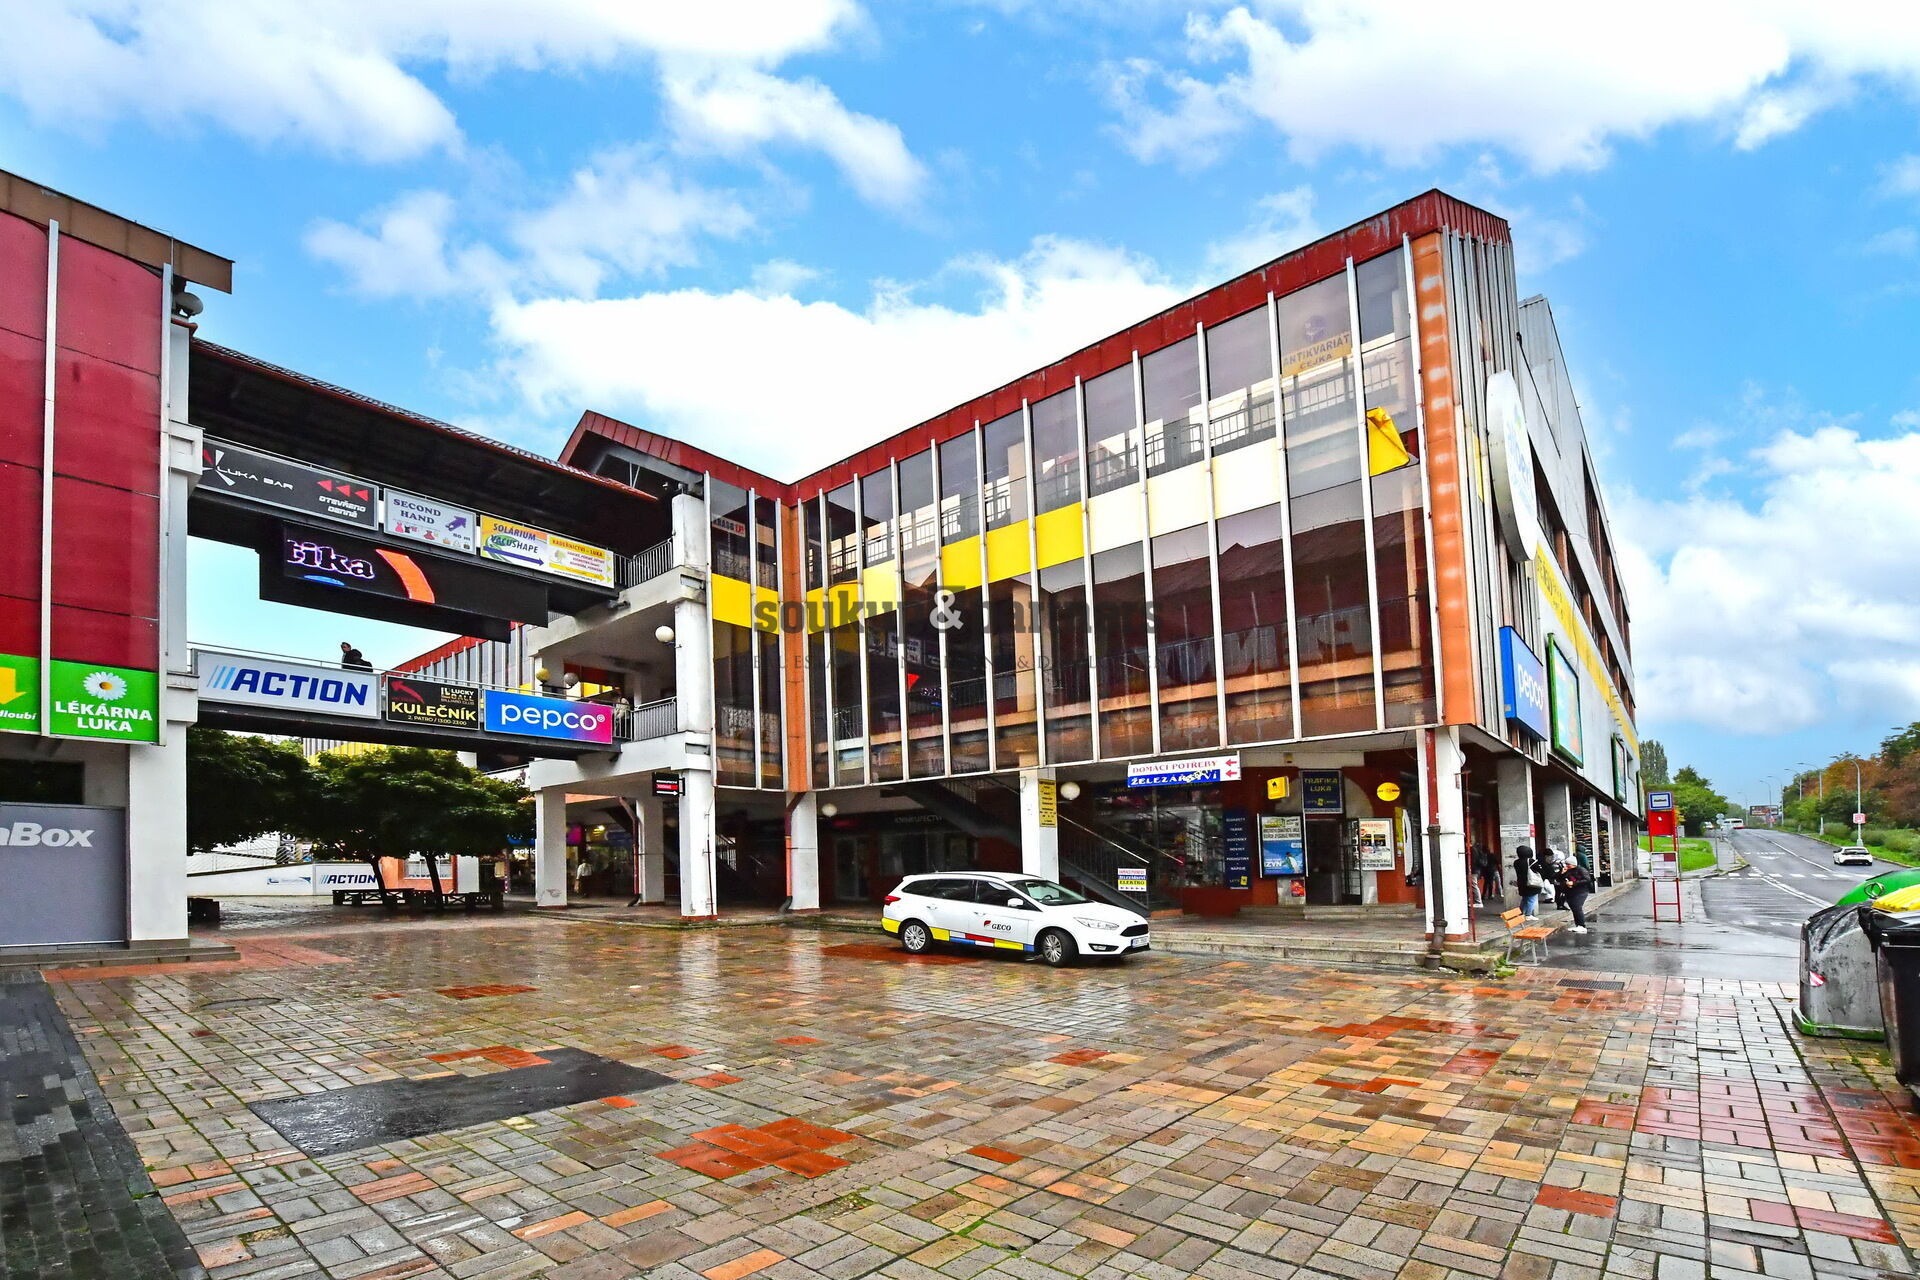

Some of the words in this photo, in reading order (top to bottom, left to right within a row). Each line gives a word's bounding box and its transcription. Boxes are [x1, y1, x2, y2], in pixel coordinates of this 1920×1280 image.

[216, 465, 259, 482] LUKA
[263, 477, 294, 491] BAR
[393, 498, 441, 517] SECOND
[400, 510, 435, 525] HAND
[490, 534, 539, 554] VACUSHAPE
[231, 668, 369, 706] ACTION
[450, 688, 475, 696] LUCKY
[1517, 663, 1544, 711] pepco
[55, 700, 153, 721] LÉKÁRNA
[391, 701, 477, 721] KULEČNÍK
[77, 716, 133, 733] LUKA
[326, 874, 376, 884] ACTION
[991, 923, 1012, 931] GECO
